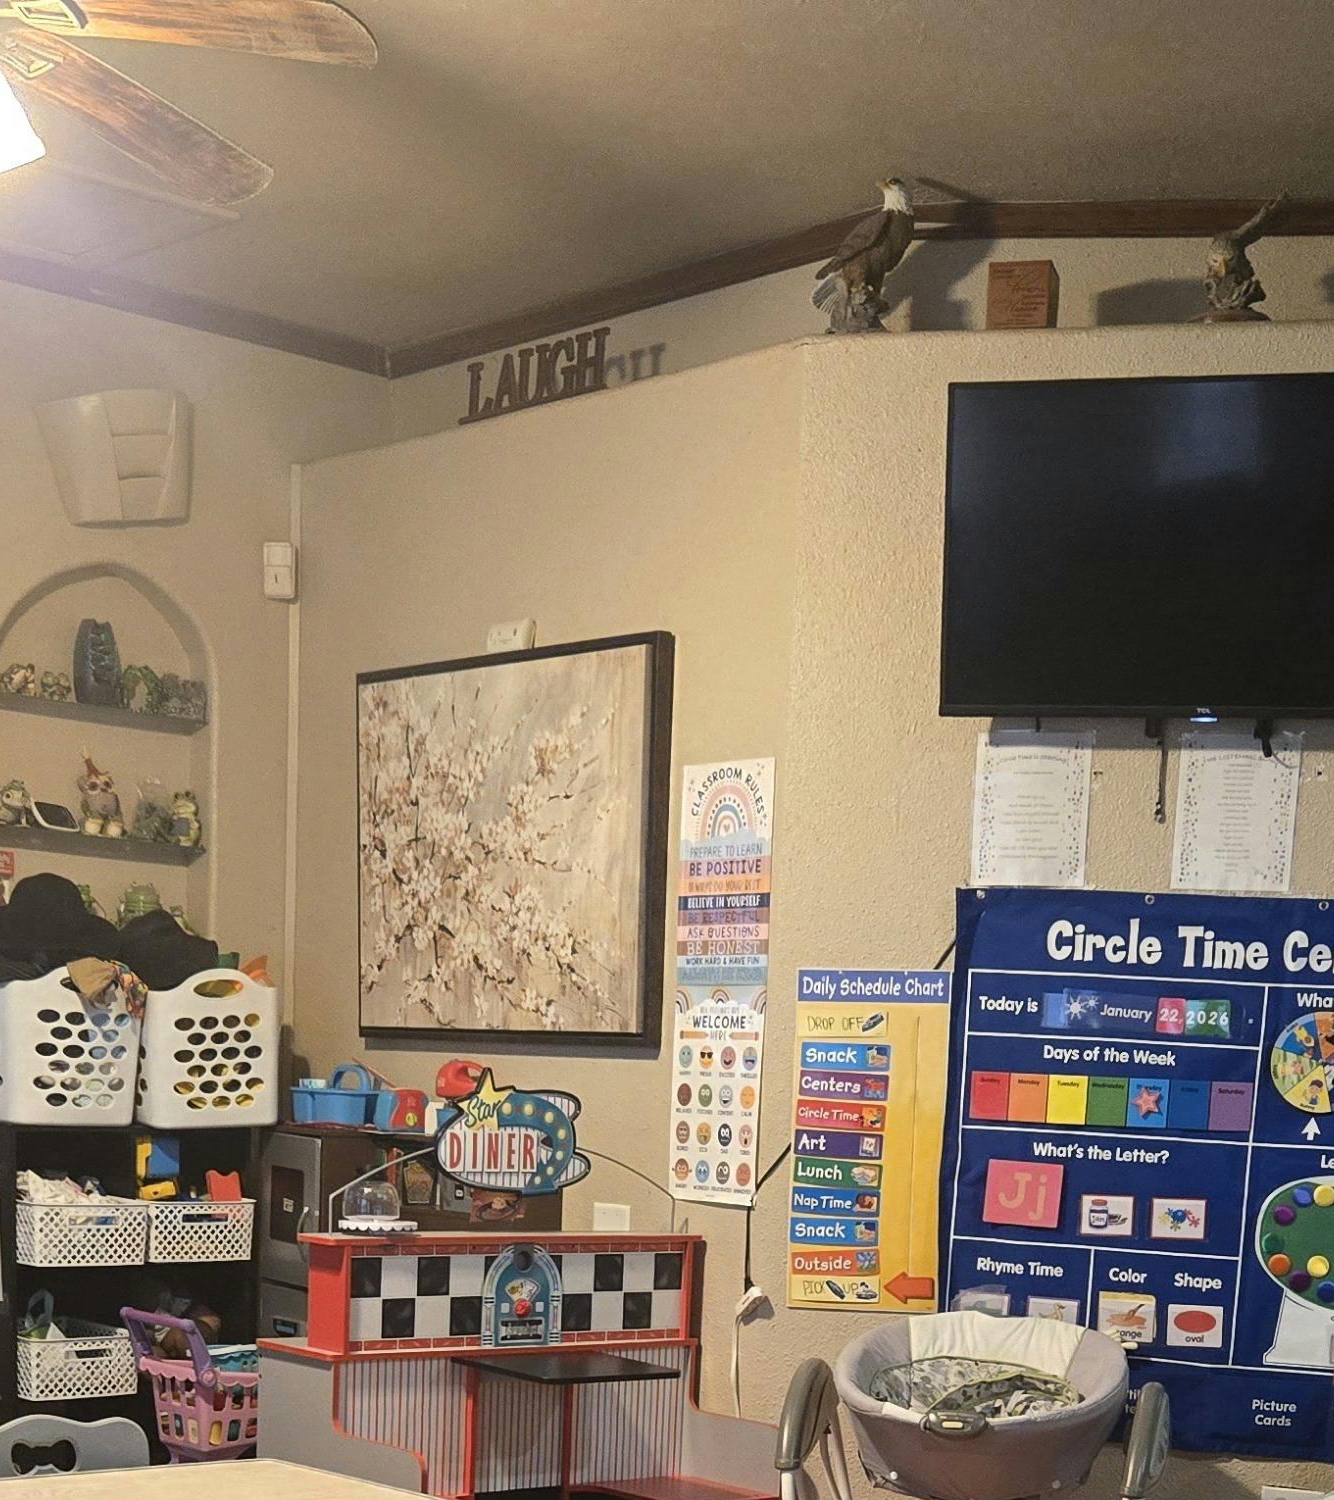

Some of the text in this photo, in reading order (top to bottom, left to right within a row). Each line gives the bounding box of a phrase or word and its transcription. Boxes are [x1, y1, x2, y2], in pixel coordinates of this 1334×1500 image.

[466, 326, 611, 419] LAUGH
[691, 767, 765, 817] CLASSROOM RULES
[690, 842, 763, 858] PREPARE TO LEARN
[689, 859, 762, 876] BE POSITIVE
[687, 895, 761, 909] BELIEVE IN YOURSELF
[688, 910, 760, 924] BE RESPECTFUL
[687, 925, 760, 939] ASK QUESTIONS
[687, 940, 760, 955] BE HONEST
[1046, 917, 1163, 966] Circle
[1178, 926, 1269, 971] Time
[685, 958, 704, 966] WORK
[706, 957, 722, 966] HARD
[728, 956, 745, 965] HAVE
[747, 956, 760, 964] FUN
[802, 975, 944, 1000] Daily Schedule Chart
[979, 995, 1024, 1015] Today
[1026, 996, 1038, 1012] is
[1100, 1003, 1153, 1023] January
[1185, 1009, 1229, 1026] 2026
[692, 1015, 746, 1029] WELCOME
[807, 1014, 864, 1032] DROP OFF
[805, 1046, 858, 1064] Snack
[1043, 1045, 1176, 1067] Days of the Week
[801, 1076, 861, 1094] Centers
[1057, 1080, 1080, 1088] Tuesday
[1217, 1087, 1245, 1096] Saturday
[464, 1096, 501, 1128] Star
[798, 1106, 861, 1122] Circle Time
[448, 1131, 537, 1170] DINER
[798, 1133, 826, 1151] Art
[1033, 1141, 1170, 1165] What's the Letter?
[797, 1162, 843, 1181] Lunch
[793, 1193, 852, 1210] Nap Time
[794, 1222, 846, 1238] Snack
[793, 1256, 852, 1271] Outside
[976, 1257, 1064, 1278] Rhyme Time
[842, 1281, 857, 1295] UP
[1108, 1267, 1223, 1293] Color Shape
[1185, 1334, 1204, 1343] oval
[1251, 1399, 1297, 1414] Picture
[1254, 1414, 1292, 1428] Cards
